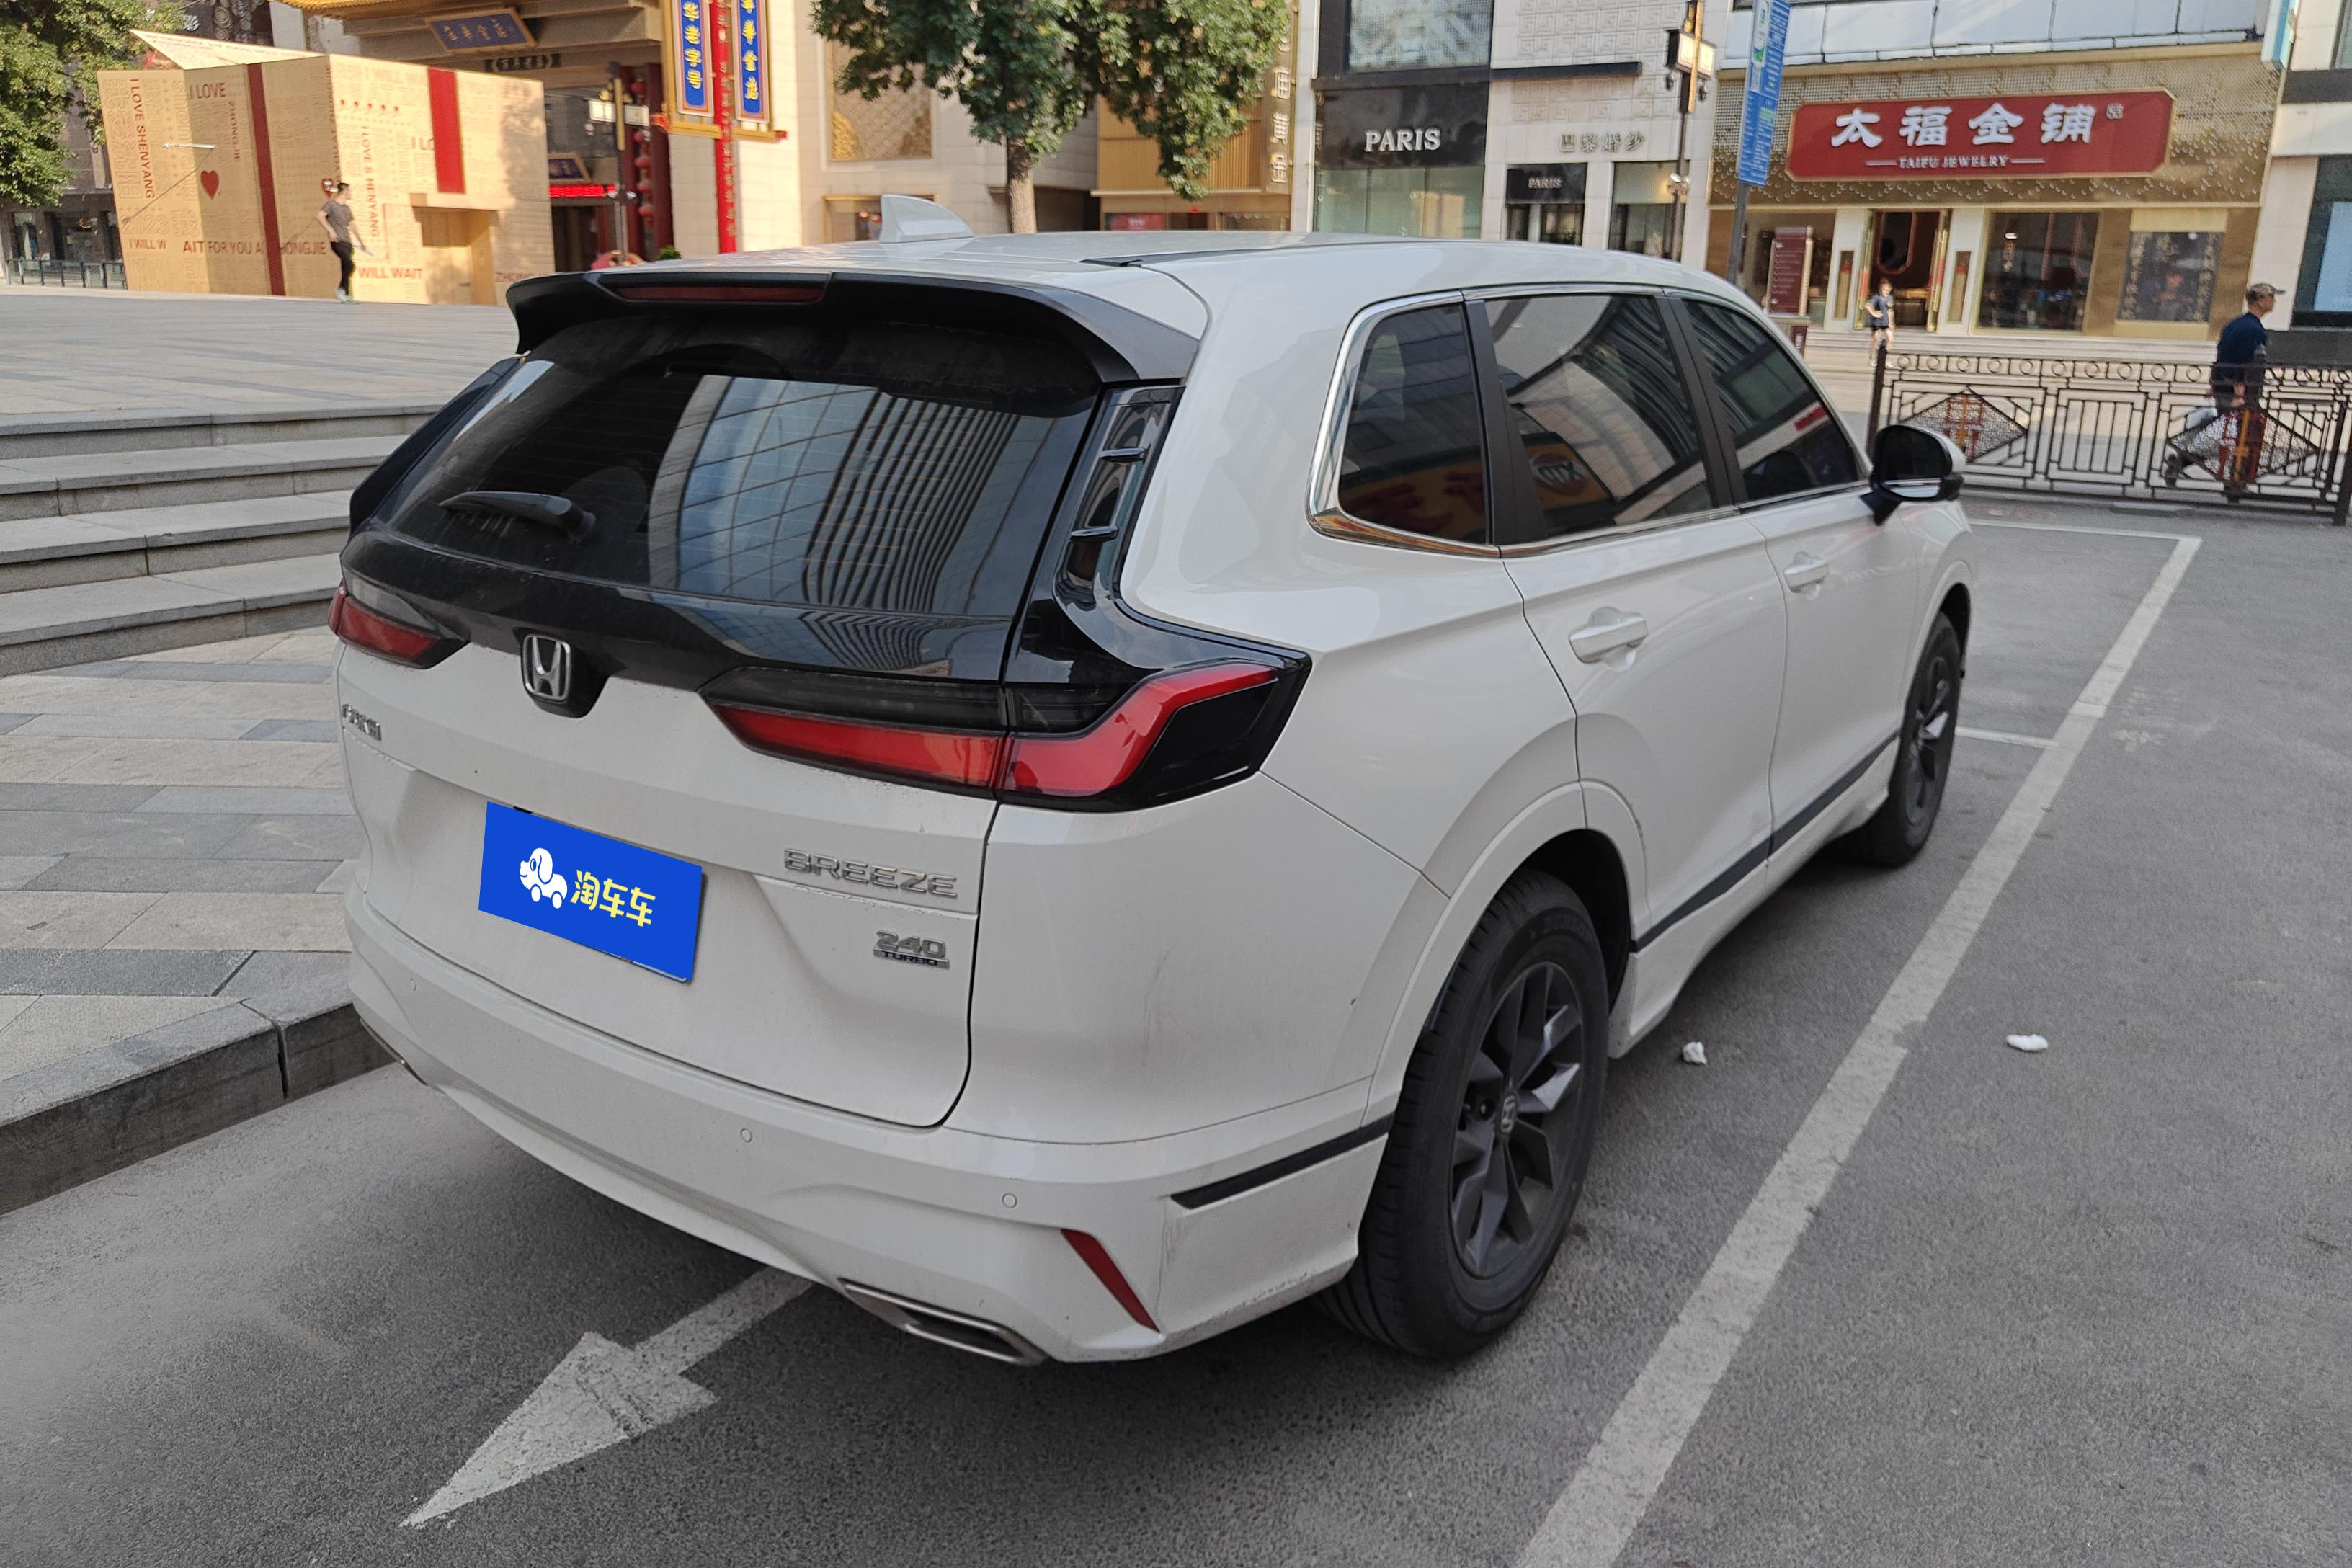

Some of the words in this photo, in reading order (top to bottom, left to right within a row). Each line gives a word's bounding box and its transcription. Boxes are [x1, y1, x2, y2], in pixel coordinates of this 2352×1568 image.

[195, 82, 227, 99] LOVE
[130, 86, 144, 121] LOVE
[1363, 128, 1441, 153] PARIS
[136, 125, 156, 199] SHENYANG
[1942, 153, 2008, 169] JEWELRY
[1528, 176, 1563, 189] PARIS
[135, 239, 156, 250] WILL
[208, 241, 227, 254] FOR
[228, 241, 252, 255] YOU
[357, 267, 388, 279] WILL
[390, 268, 423, 279] WAIT
[783, 847, 958, 899] BREEZE
[876, 930, 946, 958] 240
[881, 950, 938, 966] TURBO
